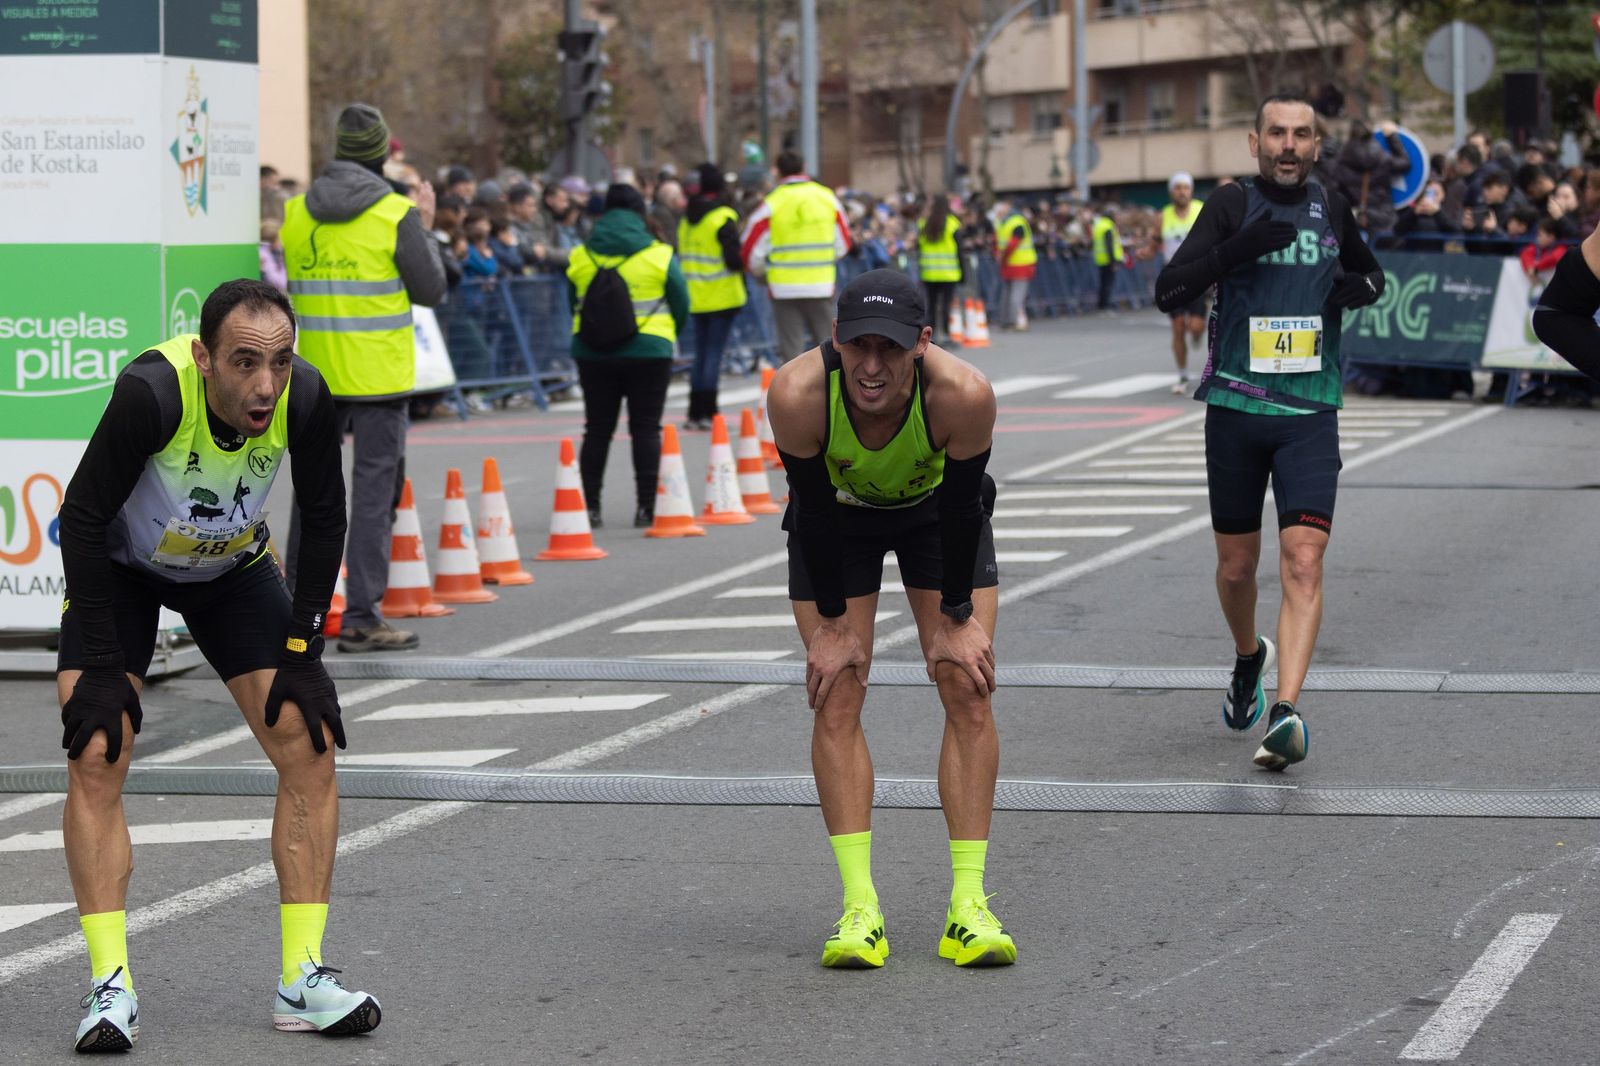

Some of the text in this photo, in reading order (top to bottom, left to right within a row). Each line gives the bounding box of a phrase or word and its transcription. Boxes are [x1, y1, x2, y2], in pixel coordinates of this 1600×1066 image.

[1, 7, 98, 18] VISUALES A MEDIDA
[1, 130, 145, 150] San Estanislao
[1, 153, 98, 174] de Kostka
[863, 295, 894, 305] KIPRUN
[1270, 320, 1317, 330] SETEL
[1275, 332, 1292, 353] 41
[16, 340, 129, 390] pilar
[192, 541, 229, 555] 48
